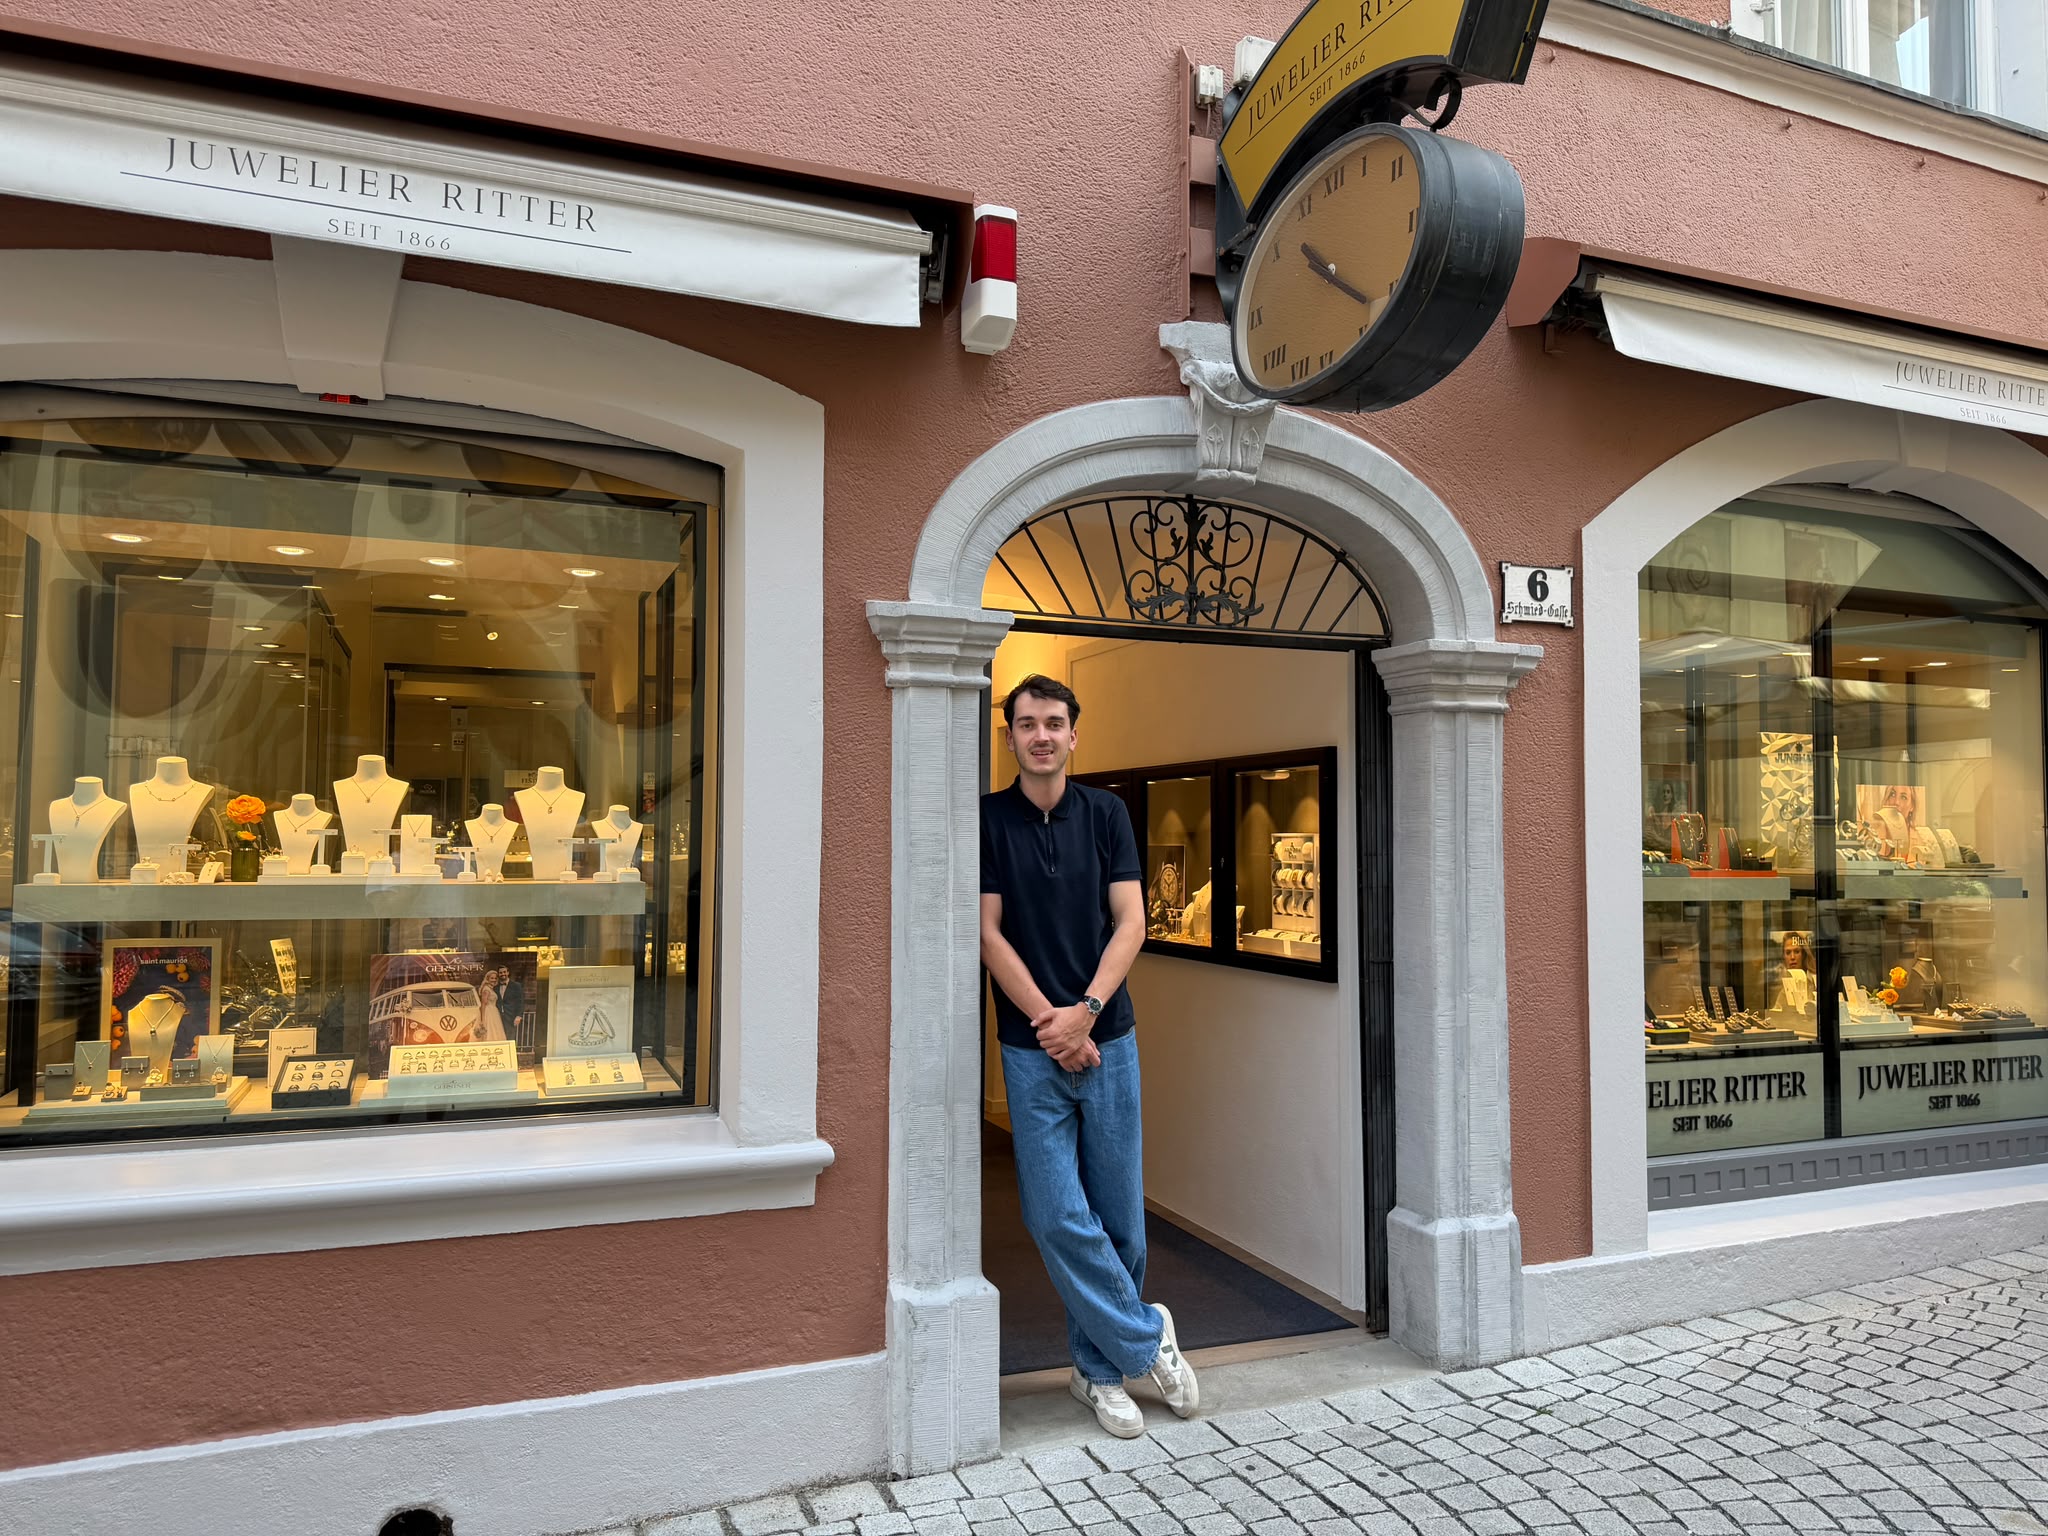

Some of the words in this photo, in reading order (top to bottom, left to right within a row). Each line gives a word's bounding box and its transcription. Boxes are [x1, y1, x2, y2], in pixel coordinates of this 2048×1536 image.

[1248, 22, 1347, 137] JUWELIER
[1360, 0, 1394, 30] RI
[1309, 76, 1334, 107] SEIT
[1339, 50, 1366, 81] 1866
[165, 137, 412, 203] JUWELIER
[442, 182, 597, 233] RITTER
[1323, 165, 1345, 199] XII
[327, 218, 382, 241] SEIT
[397, 229, 452, 251] 1866
[1896, 361, 1987, 396] JUWELIER
[1997, 380, 2045, 407] RITTE
[1959, 407, 1980, 421] SEIT
[1986, 412, 2007, 425] 1866
[1527, 569, 1549, 602] 6
[1646, 1078, 1718, 1109] ELIER
[1724, 1071, 1807, 1103] RITTER
[1858, 1060, 1967, 1100] JUWELIER
[1972, 1055, 2044, 1083] RITTER
[1928, 1095, 1953, 1110] SEIT
[1955, 1093, 1981, 1107] 1866
[1672, 1115, 1701, 1132] SEIT
[1704, 1113, 1733, 1129] 1866
